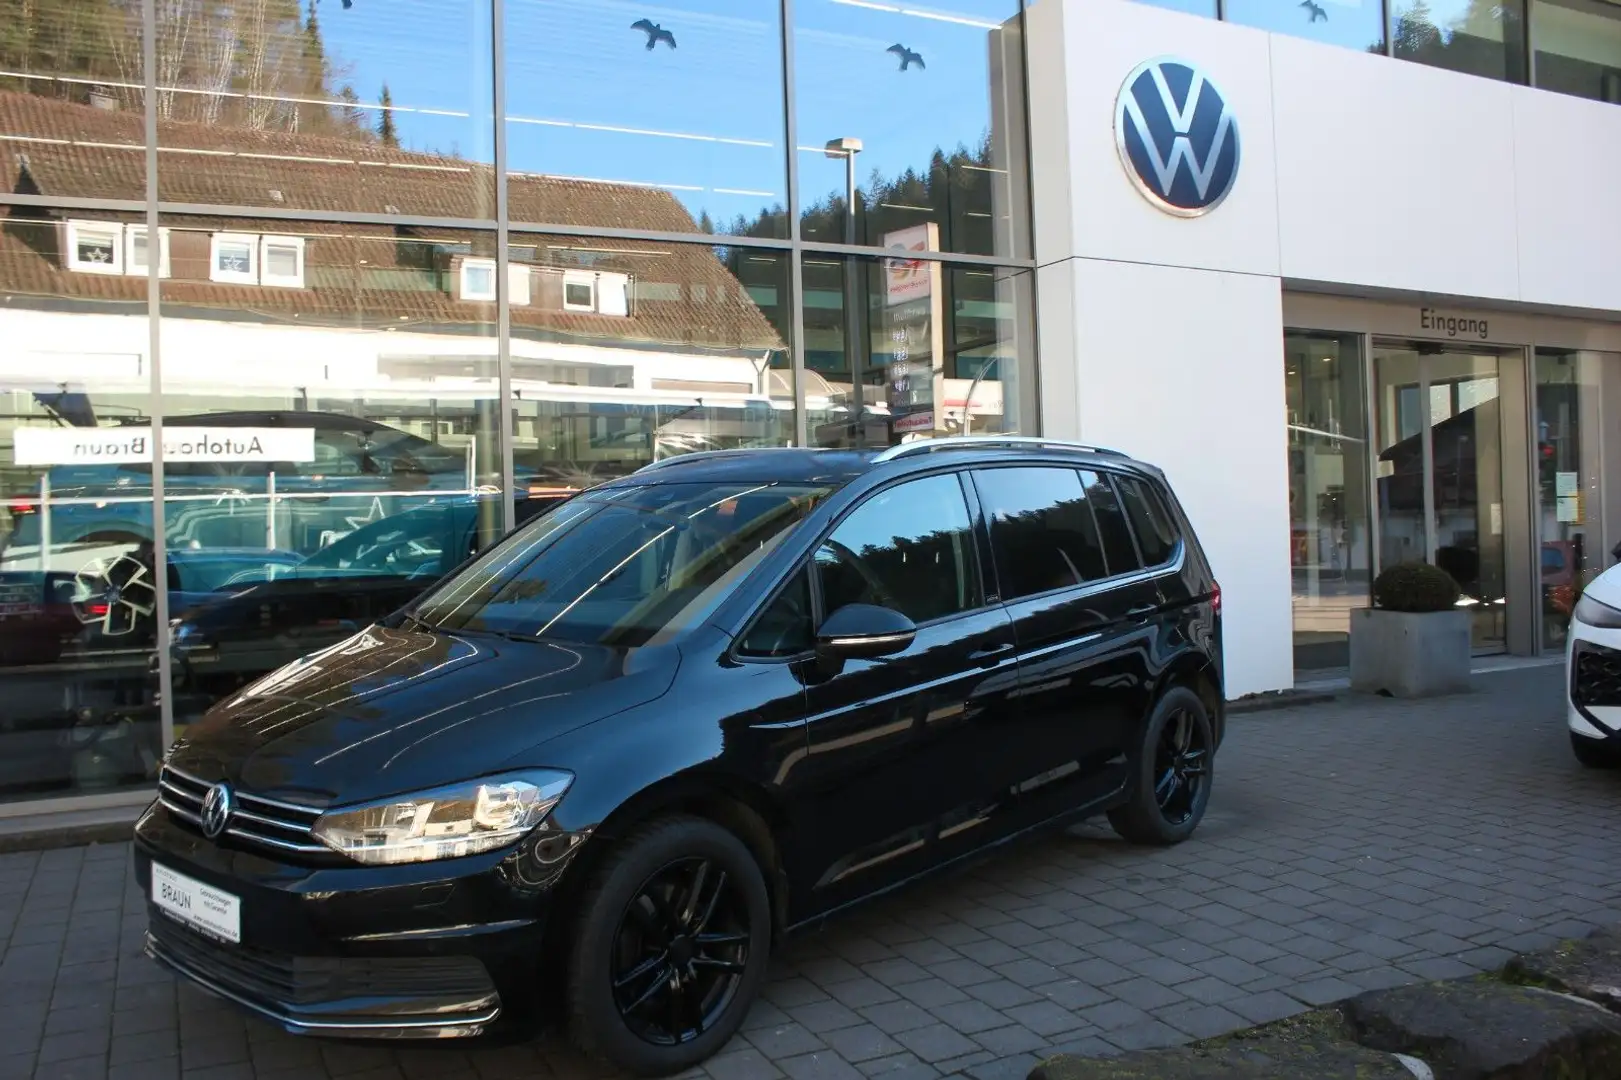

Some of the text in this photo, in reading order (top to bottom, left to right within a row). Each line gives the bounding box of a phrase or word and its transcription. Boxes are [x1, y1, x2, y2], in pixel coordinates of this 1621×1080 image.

[1117, 60, 1236, 203] VW
[1420, 307, 1488, 339] Eingang
[161, 882, 192, 909] BRAUN
